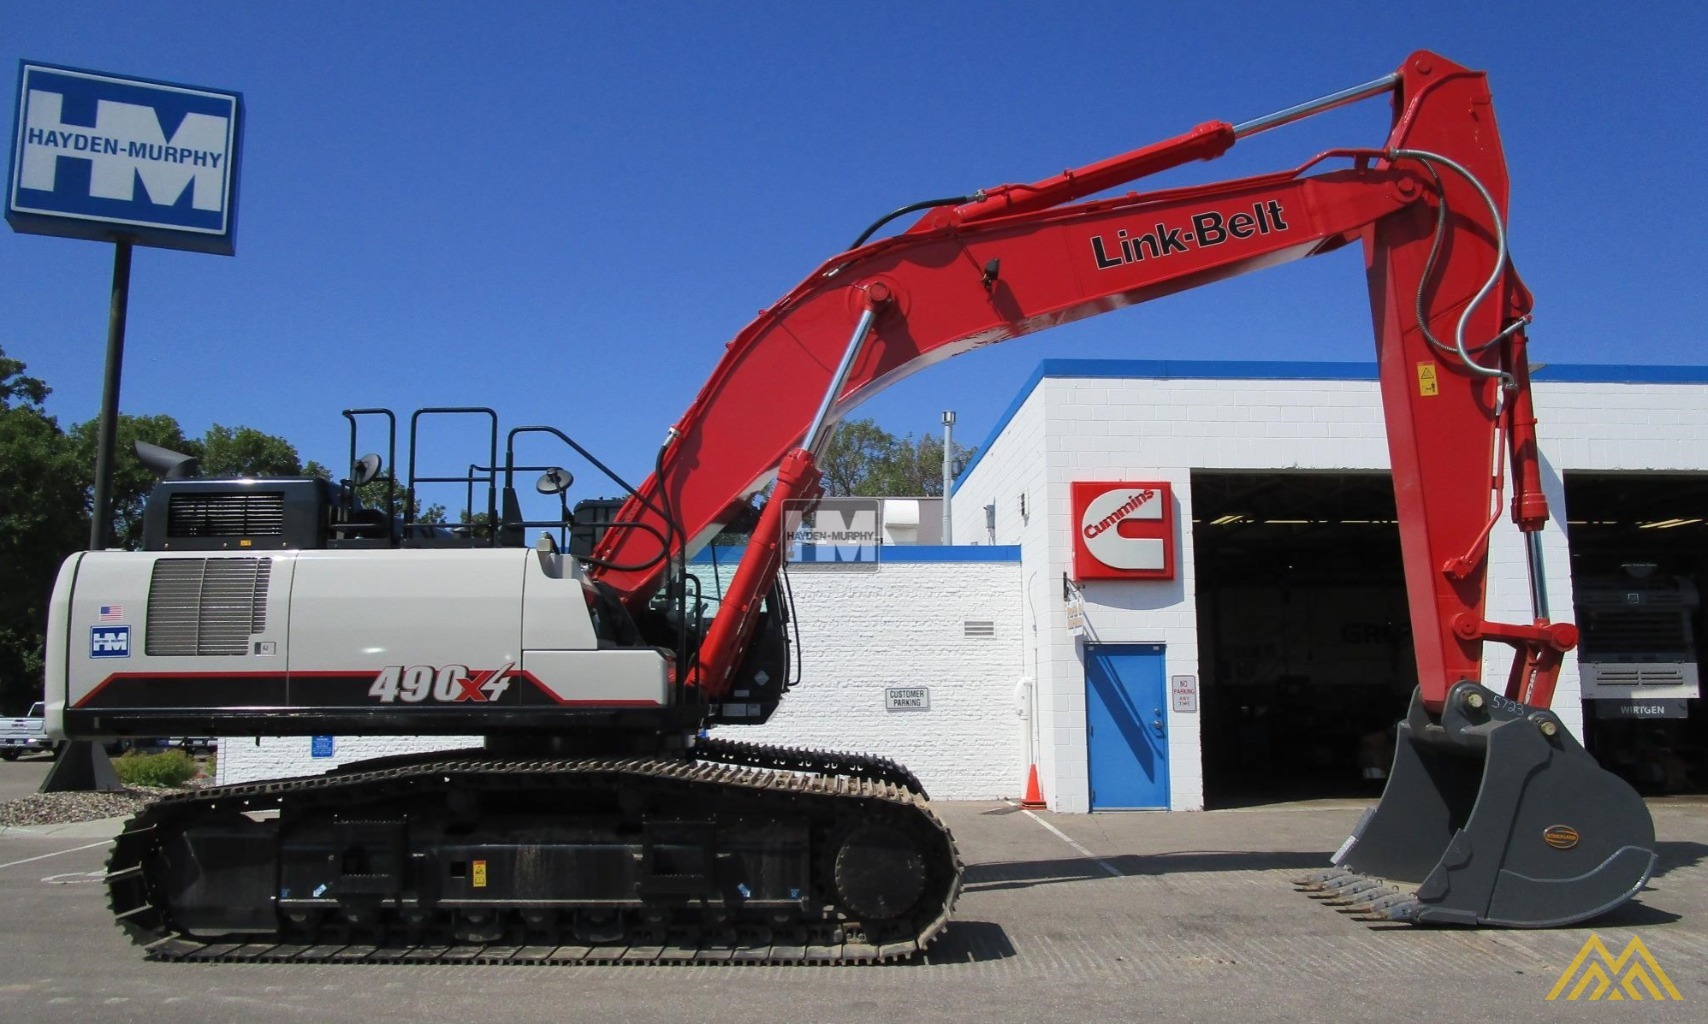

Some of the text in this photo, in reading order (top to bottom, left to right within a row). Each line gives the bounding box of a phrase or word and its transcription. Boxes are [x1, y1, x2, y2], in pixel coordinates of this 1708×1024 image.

[20, 88, 228, 212] HM
[28, 127, 222, 168] HAYDEN-MURPHY
[1090, 200, 1288, 270] Link-Belt
[1083, 488, 1155, 539] Cummins
[93, 632, 127, 650] HM
[1179, 680, 1188, 688] NO
[889, 690, 925, 699] CUSTOMER
[893, 699, 921, 707] PARKING
[1491, 695, 1524, 716] 5723
[1620, 705, 1665, 714] WIRTGEN
